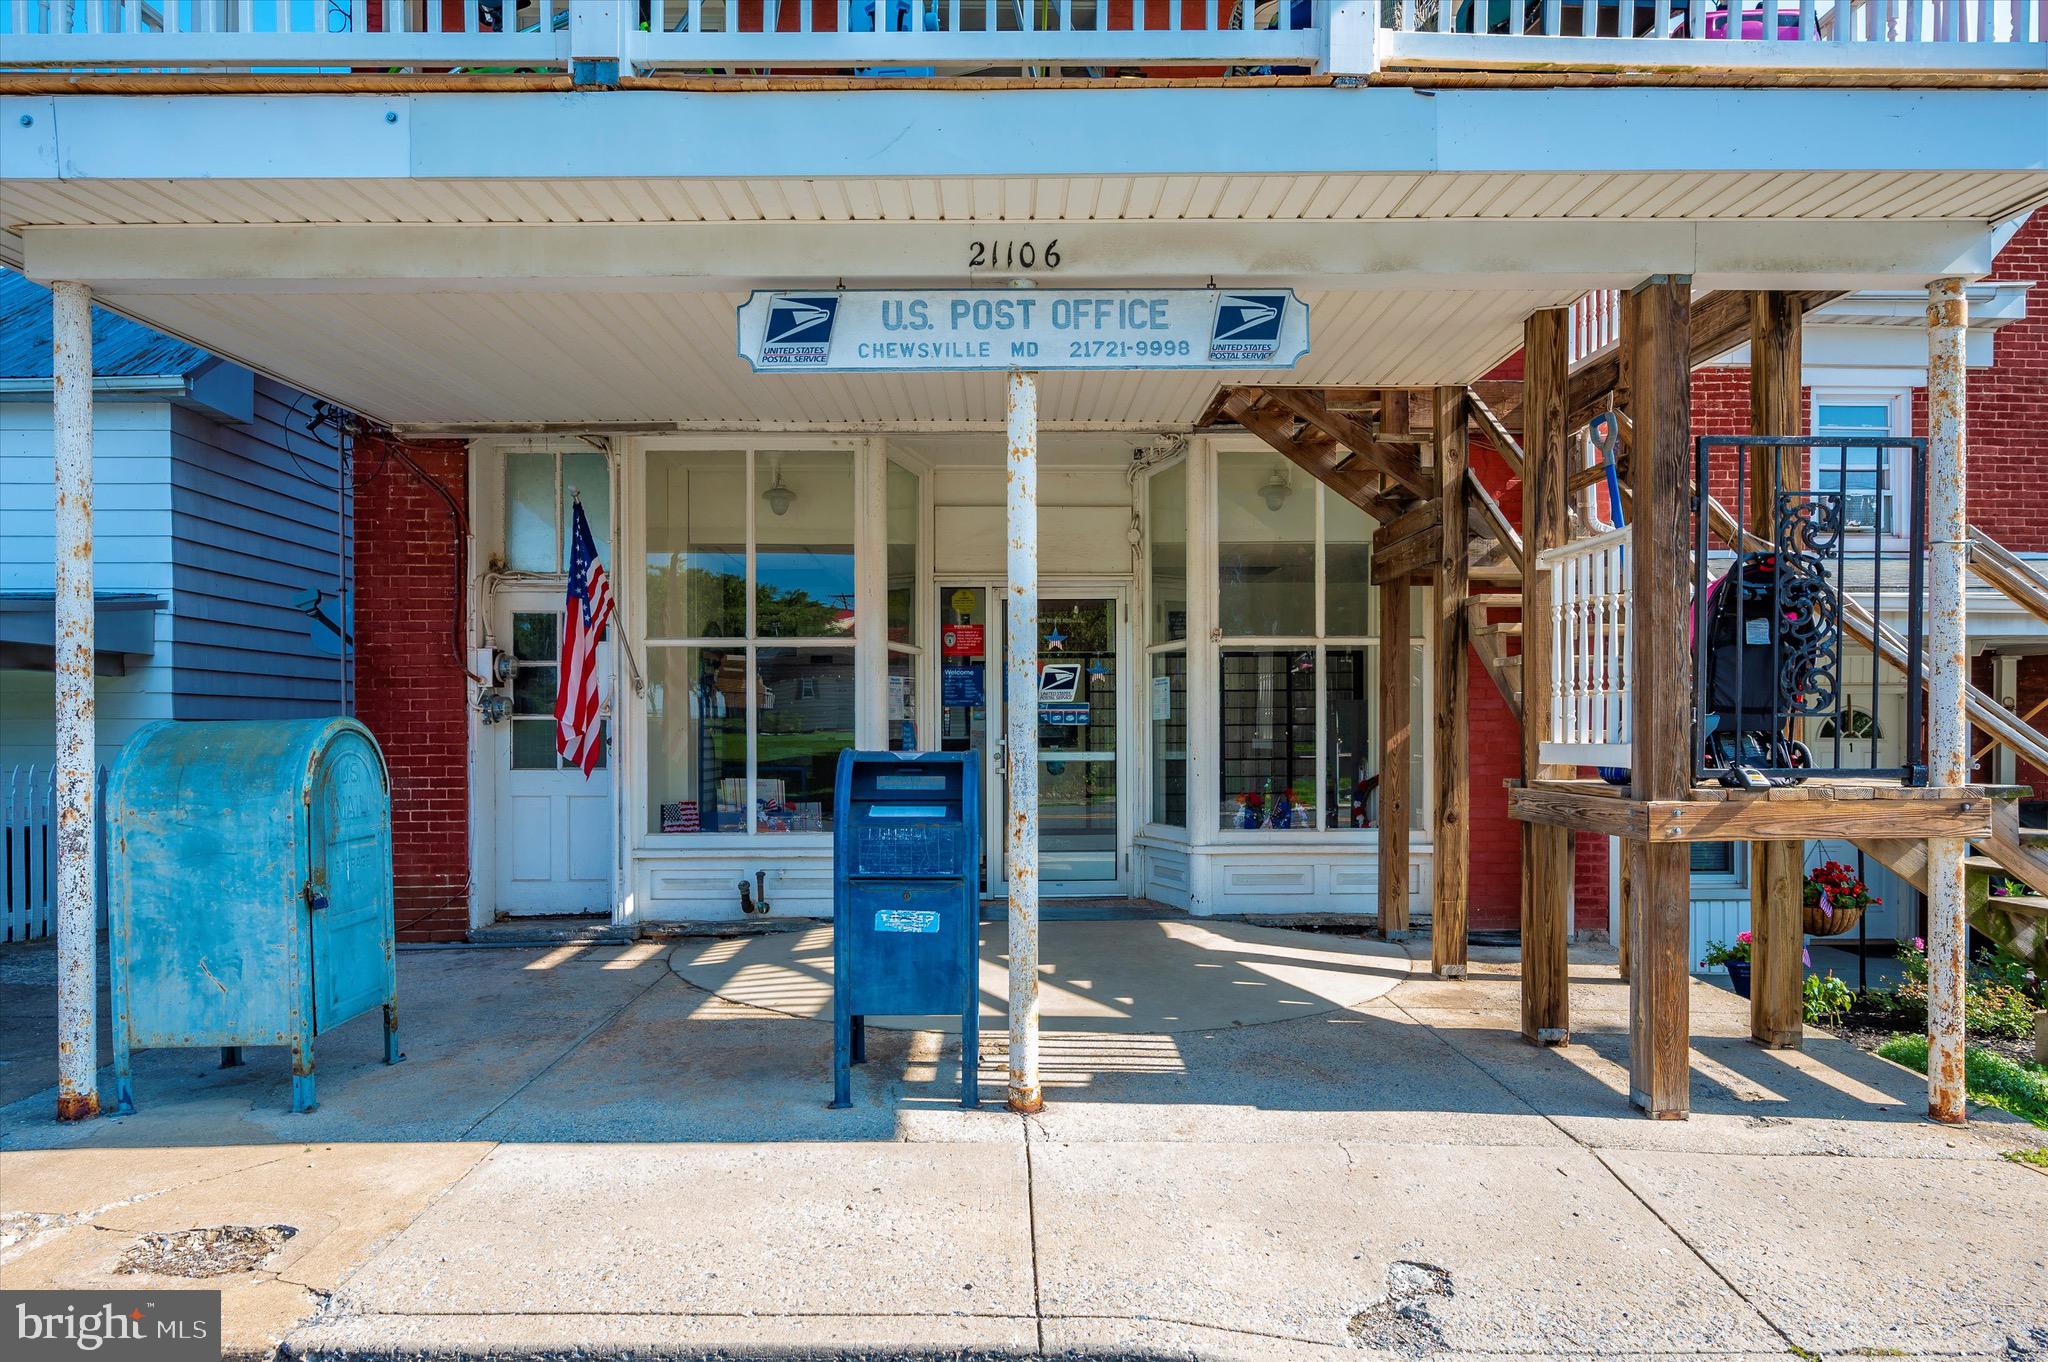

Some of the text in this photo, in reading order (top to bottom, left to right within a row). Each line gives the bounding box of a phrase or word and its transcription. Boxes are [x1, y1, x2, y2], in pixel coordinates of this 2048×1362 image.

[969, 238, 1062, 270] 21106
[881, 299, 1170, 331] U.S. POST OFFICE
[763, 347, 795, 355] UNITED
[857, 339, 1191, 359] CHEWSVILLE MD 21721-9998
[761, 355, 827, 363] POSTAL SERVICE
[944, 668, 975, 676] Welcome
[1849, 743, 1853, 752] 1
